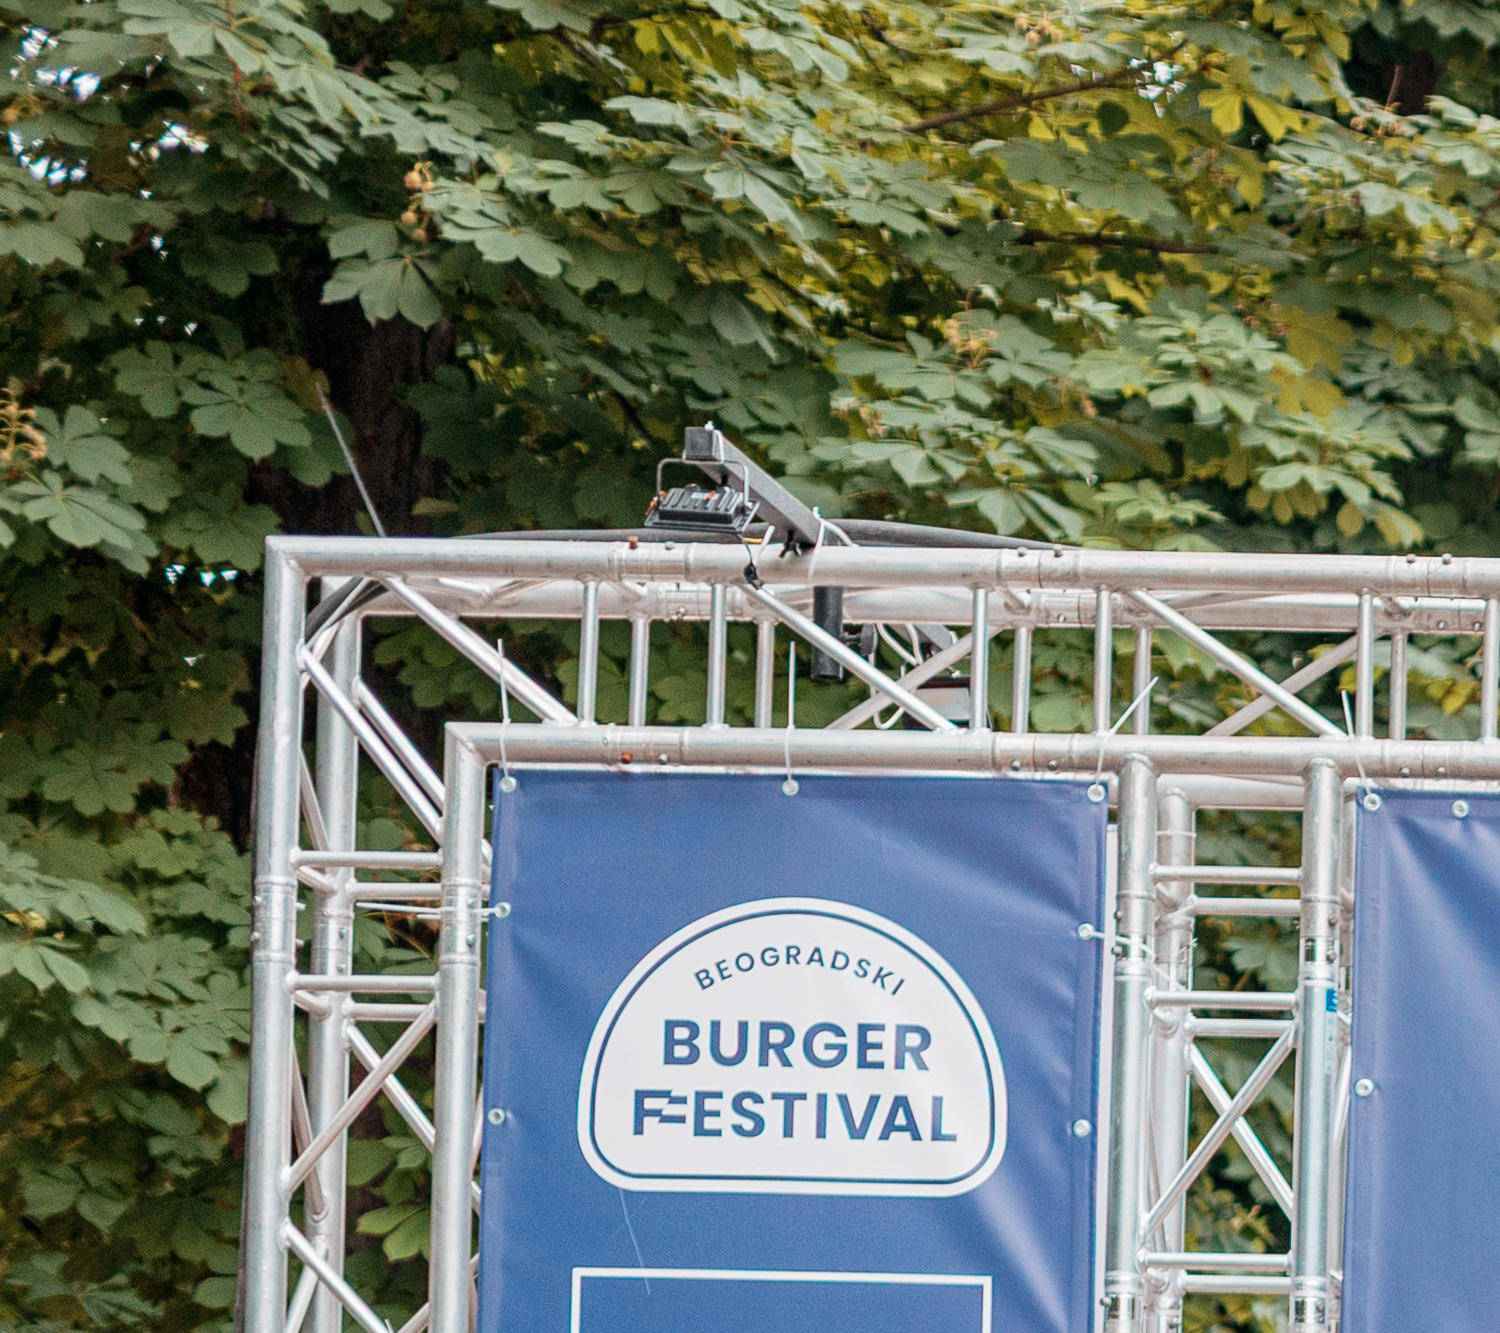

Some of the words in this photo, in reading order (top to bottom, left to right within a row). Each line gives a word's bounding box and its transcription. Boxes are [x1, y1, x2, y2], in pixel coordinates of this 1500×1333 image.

[695, 945, 906, 998] BEOGRADSKI
[662, 1018, 933, 1073] BURGER
[632, 1088, 959, 1143] FESTIVAL
